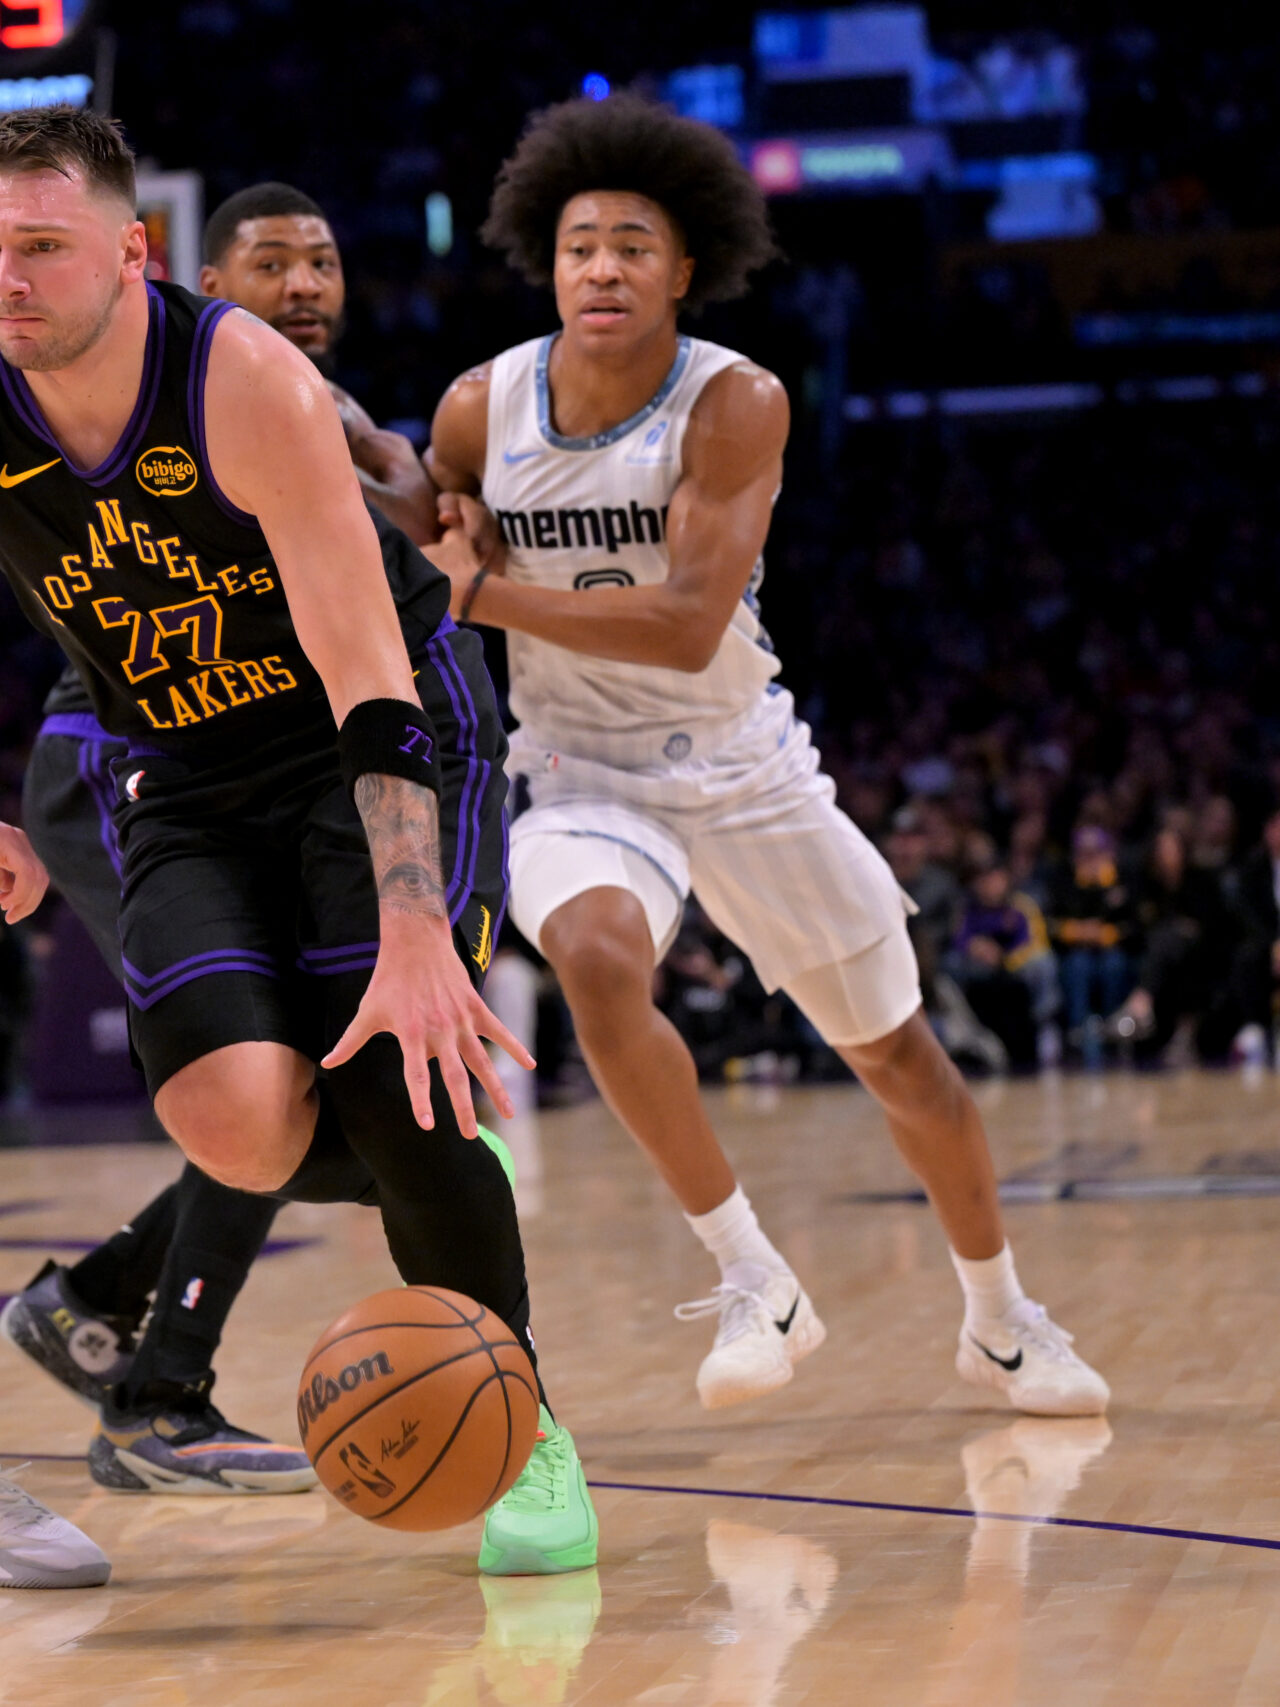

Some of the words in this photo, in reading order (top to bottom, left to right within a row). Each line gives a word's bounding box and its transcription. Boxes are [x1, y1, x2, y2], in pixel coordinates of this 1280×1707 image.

[141, 458, 194, 481] bibigo
[87, 498, 275, 598] ANGELES
[91, 593, 234, 686] 77
[137, 654, 298, 729] LAKERS
